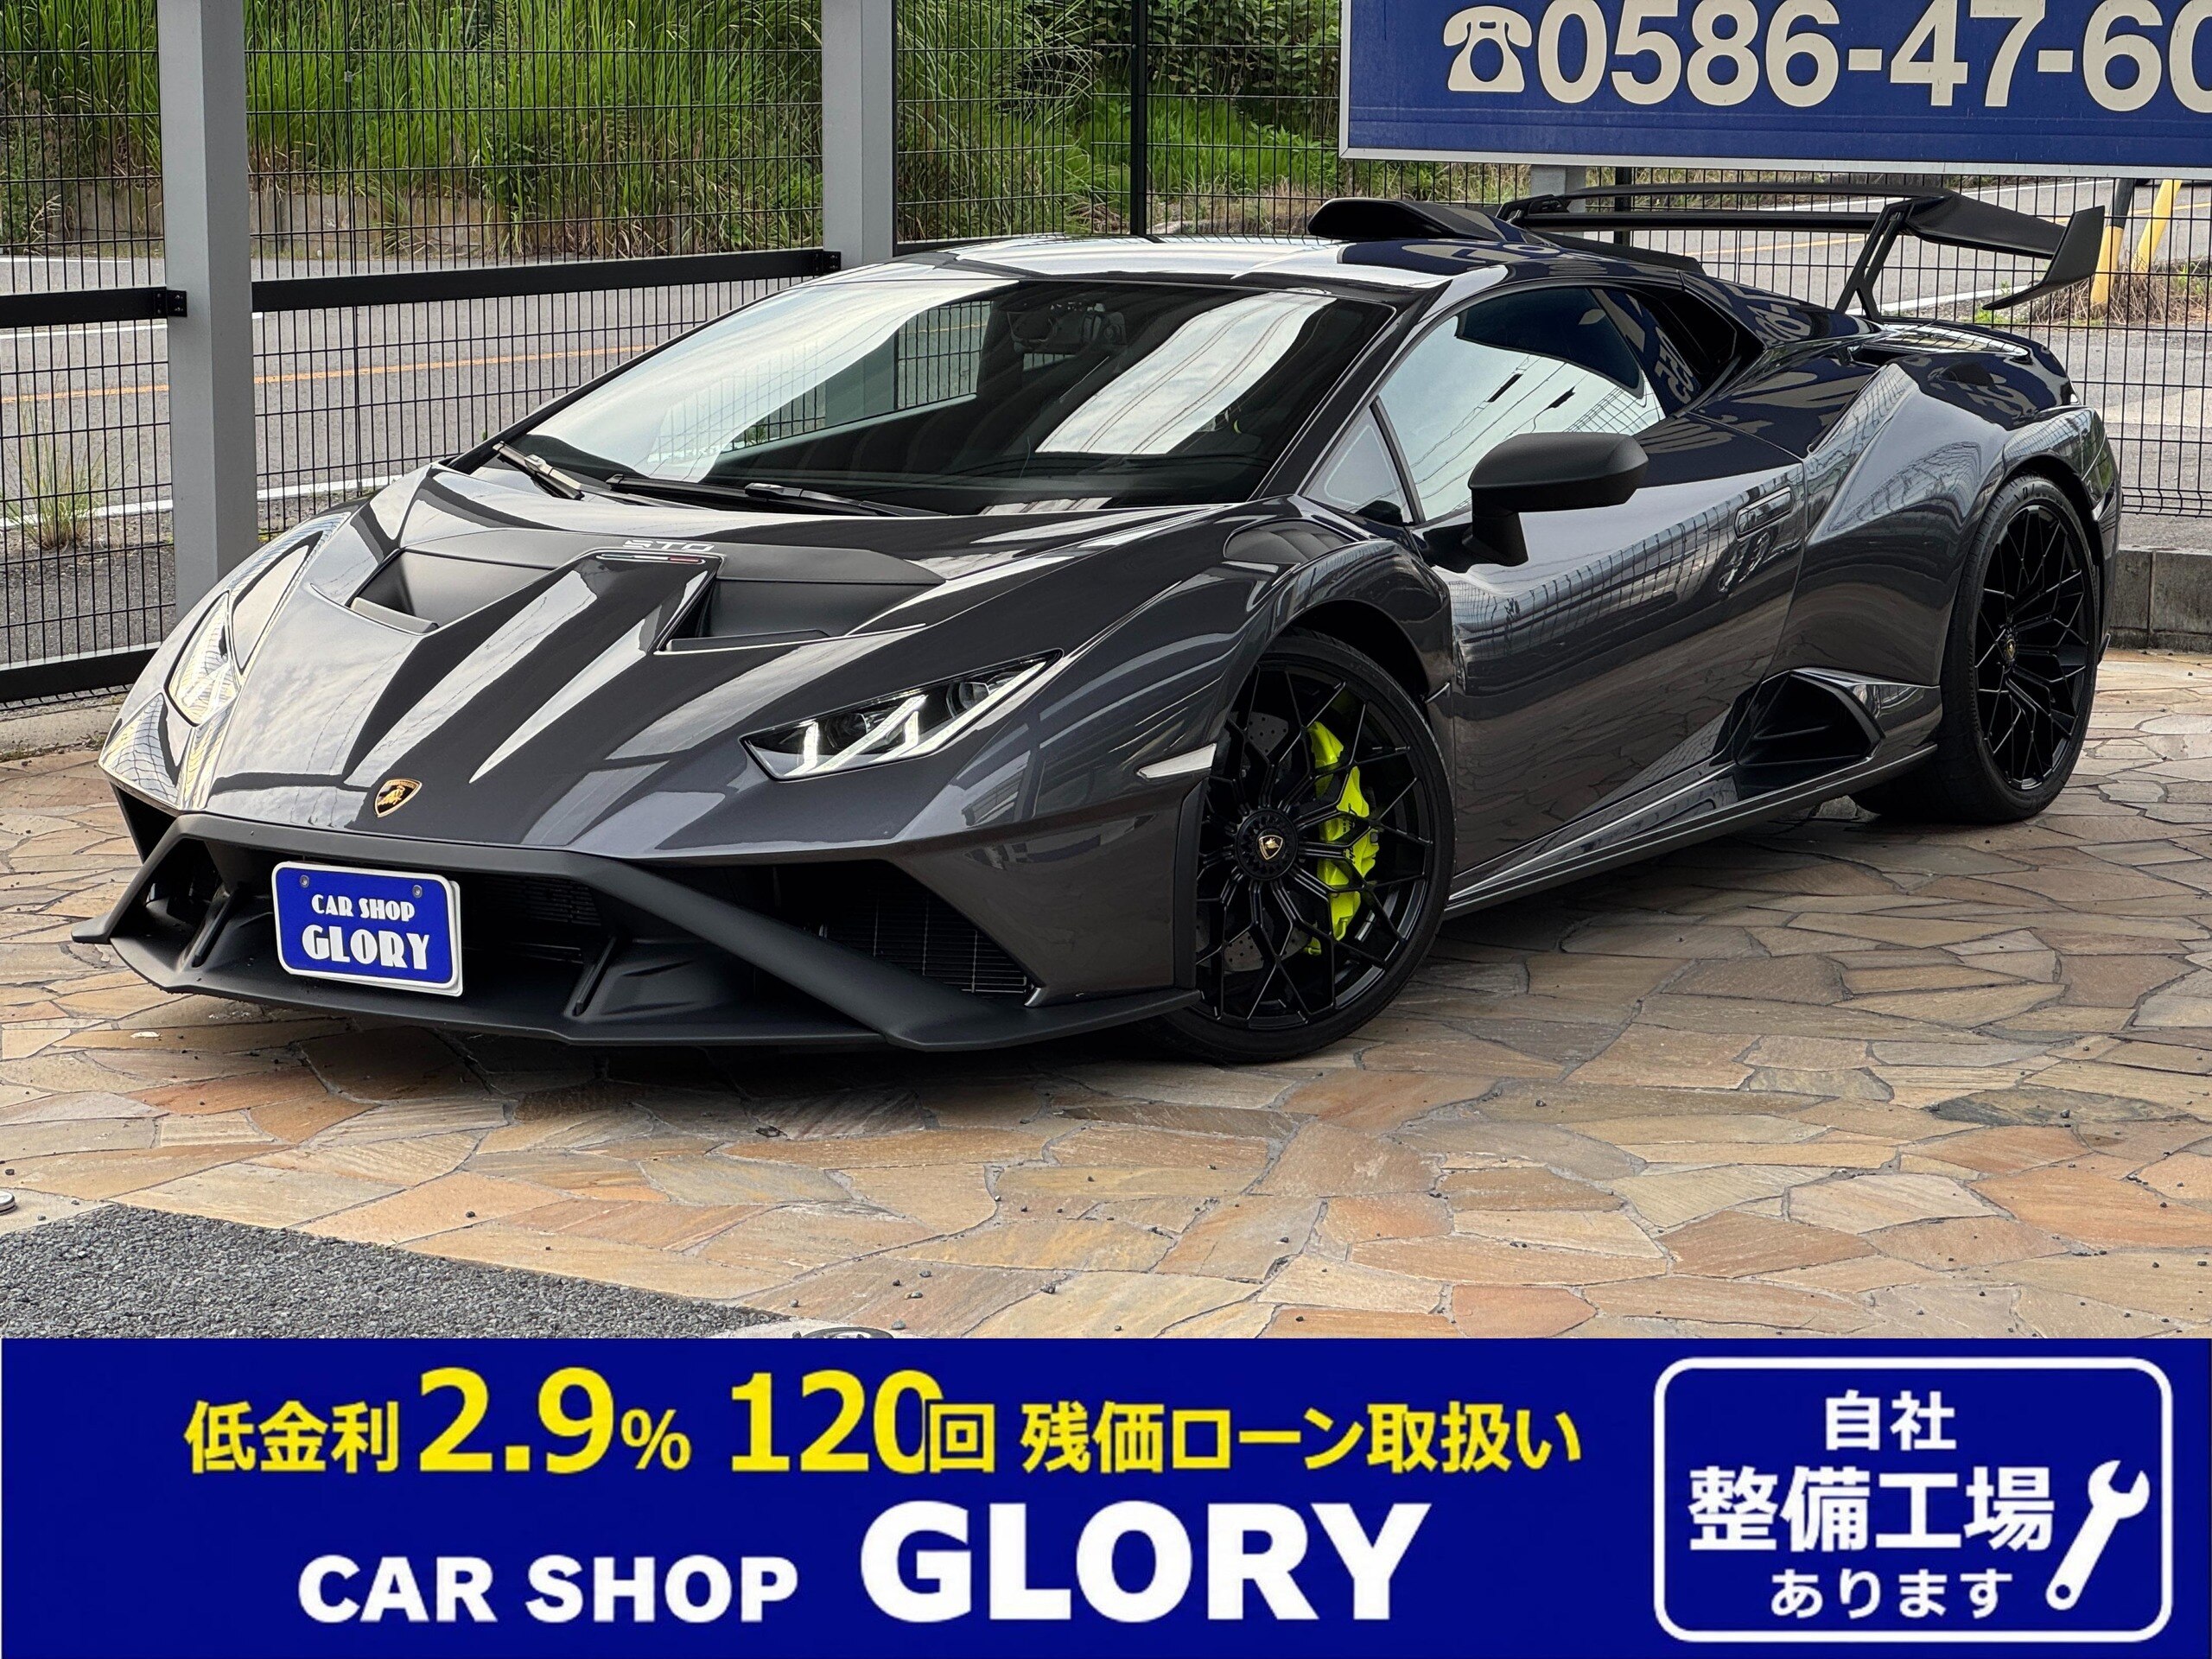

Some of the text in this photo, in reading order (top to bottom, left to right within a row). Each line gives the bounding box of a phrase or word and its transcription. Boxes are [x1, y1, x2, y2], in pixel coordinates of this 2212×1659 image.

[622, 539, 715, 552] STO
[311, 893, 416, 922] CAR SHOP
[302, 924, 430, 970] GLORY
